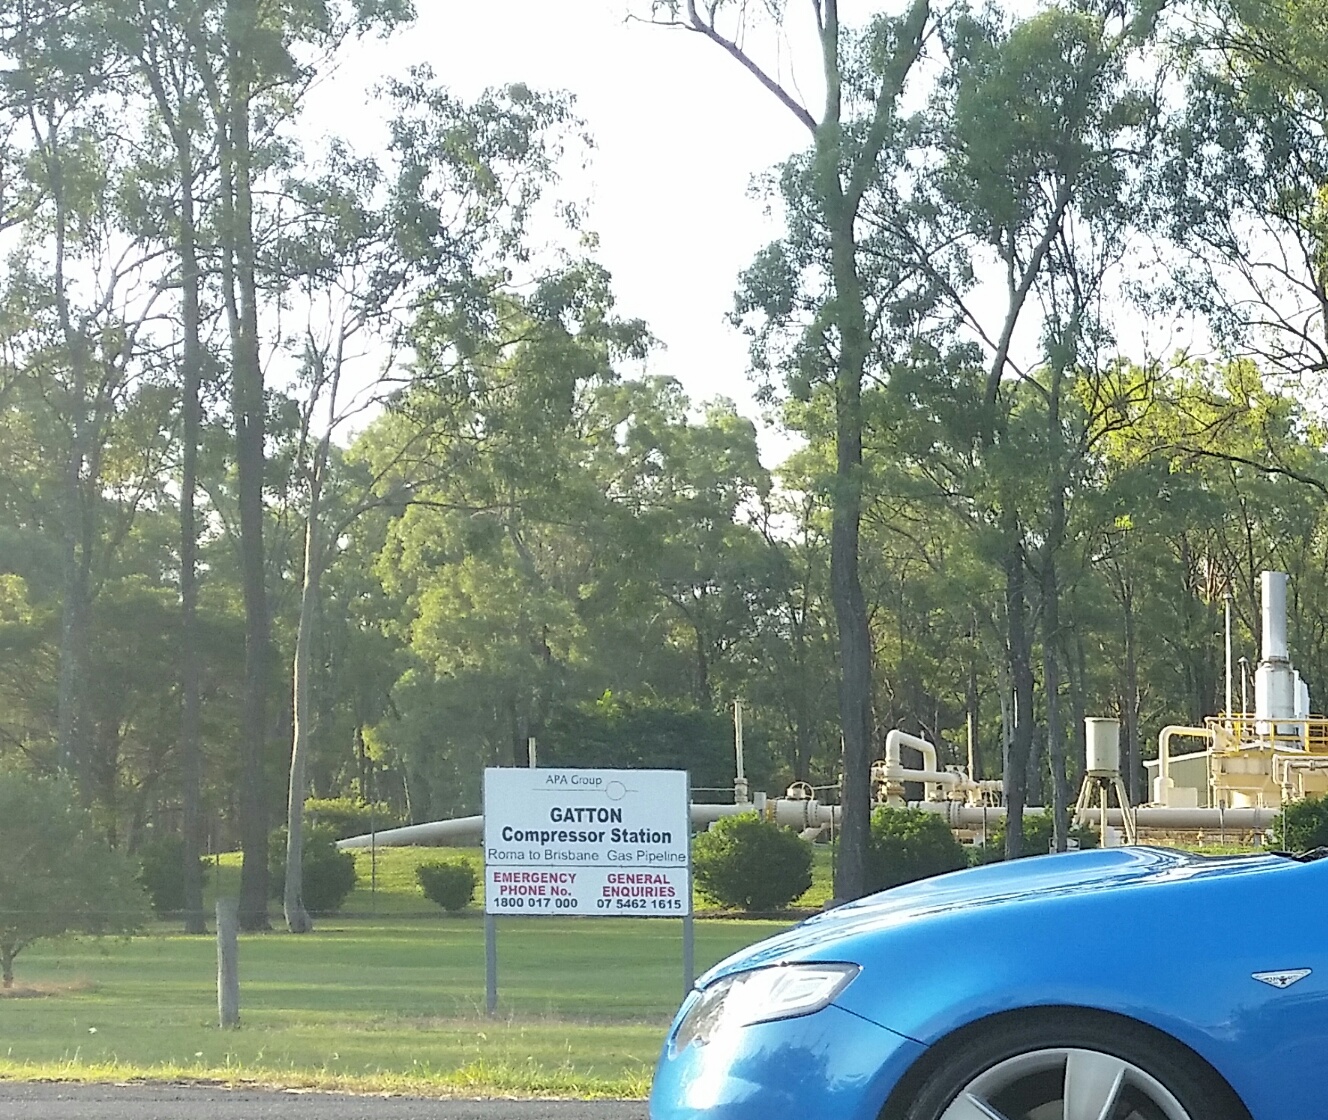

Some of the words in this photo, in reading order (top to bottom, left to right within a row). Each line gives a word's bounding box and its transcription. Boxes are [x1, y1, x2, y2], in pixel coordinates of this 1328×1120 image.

[546, 775, 568, 785] APA
[571, 775, 602, 788] Group
[550, 807, 622, 823] GATTON
[502, 826, 605, 846] Compressor
[610, 827, 672, 844] Station
[488, 849, 525, 861] Roma
[529, 850, 540, 861] to
[544, 849, 599, 861] Brisbane
[607, 850, 633, 862] Gas
[636, 850, 686, 865] Pipeline
[493, 871, 576, 884] EMERGENCY
[607, 873, 671, 884] GENERAL
[500, 885, 546, 896] PHONE
[551, 885, 572, 896] No.
[602, 886, 676, 898] ENQUIRIES
[493, 897, 524, 908] 1800
[528, 897, 551, 908] 017
[555, 898, 578, 909] 000
[597, 898, 613, 909] 07
[616, 898, 647, 909] 5462
[651, 899, 682, 910] 1615
